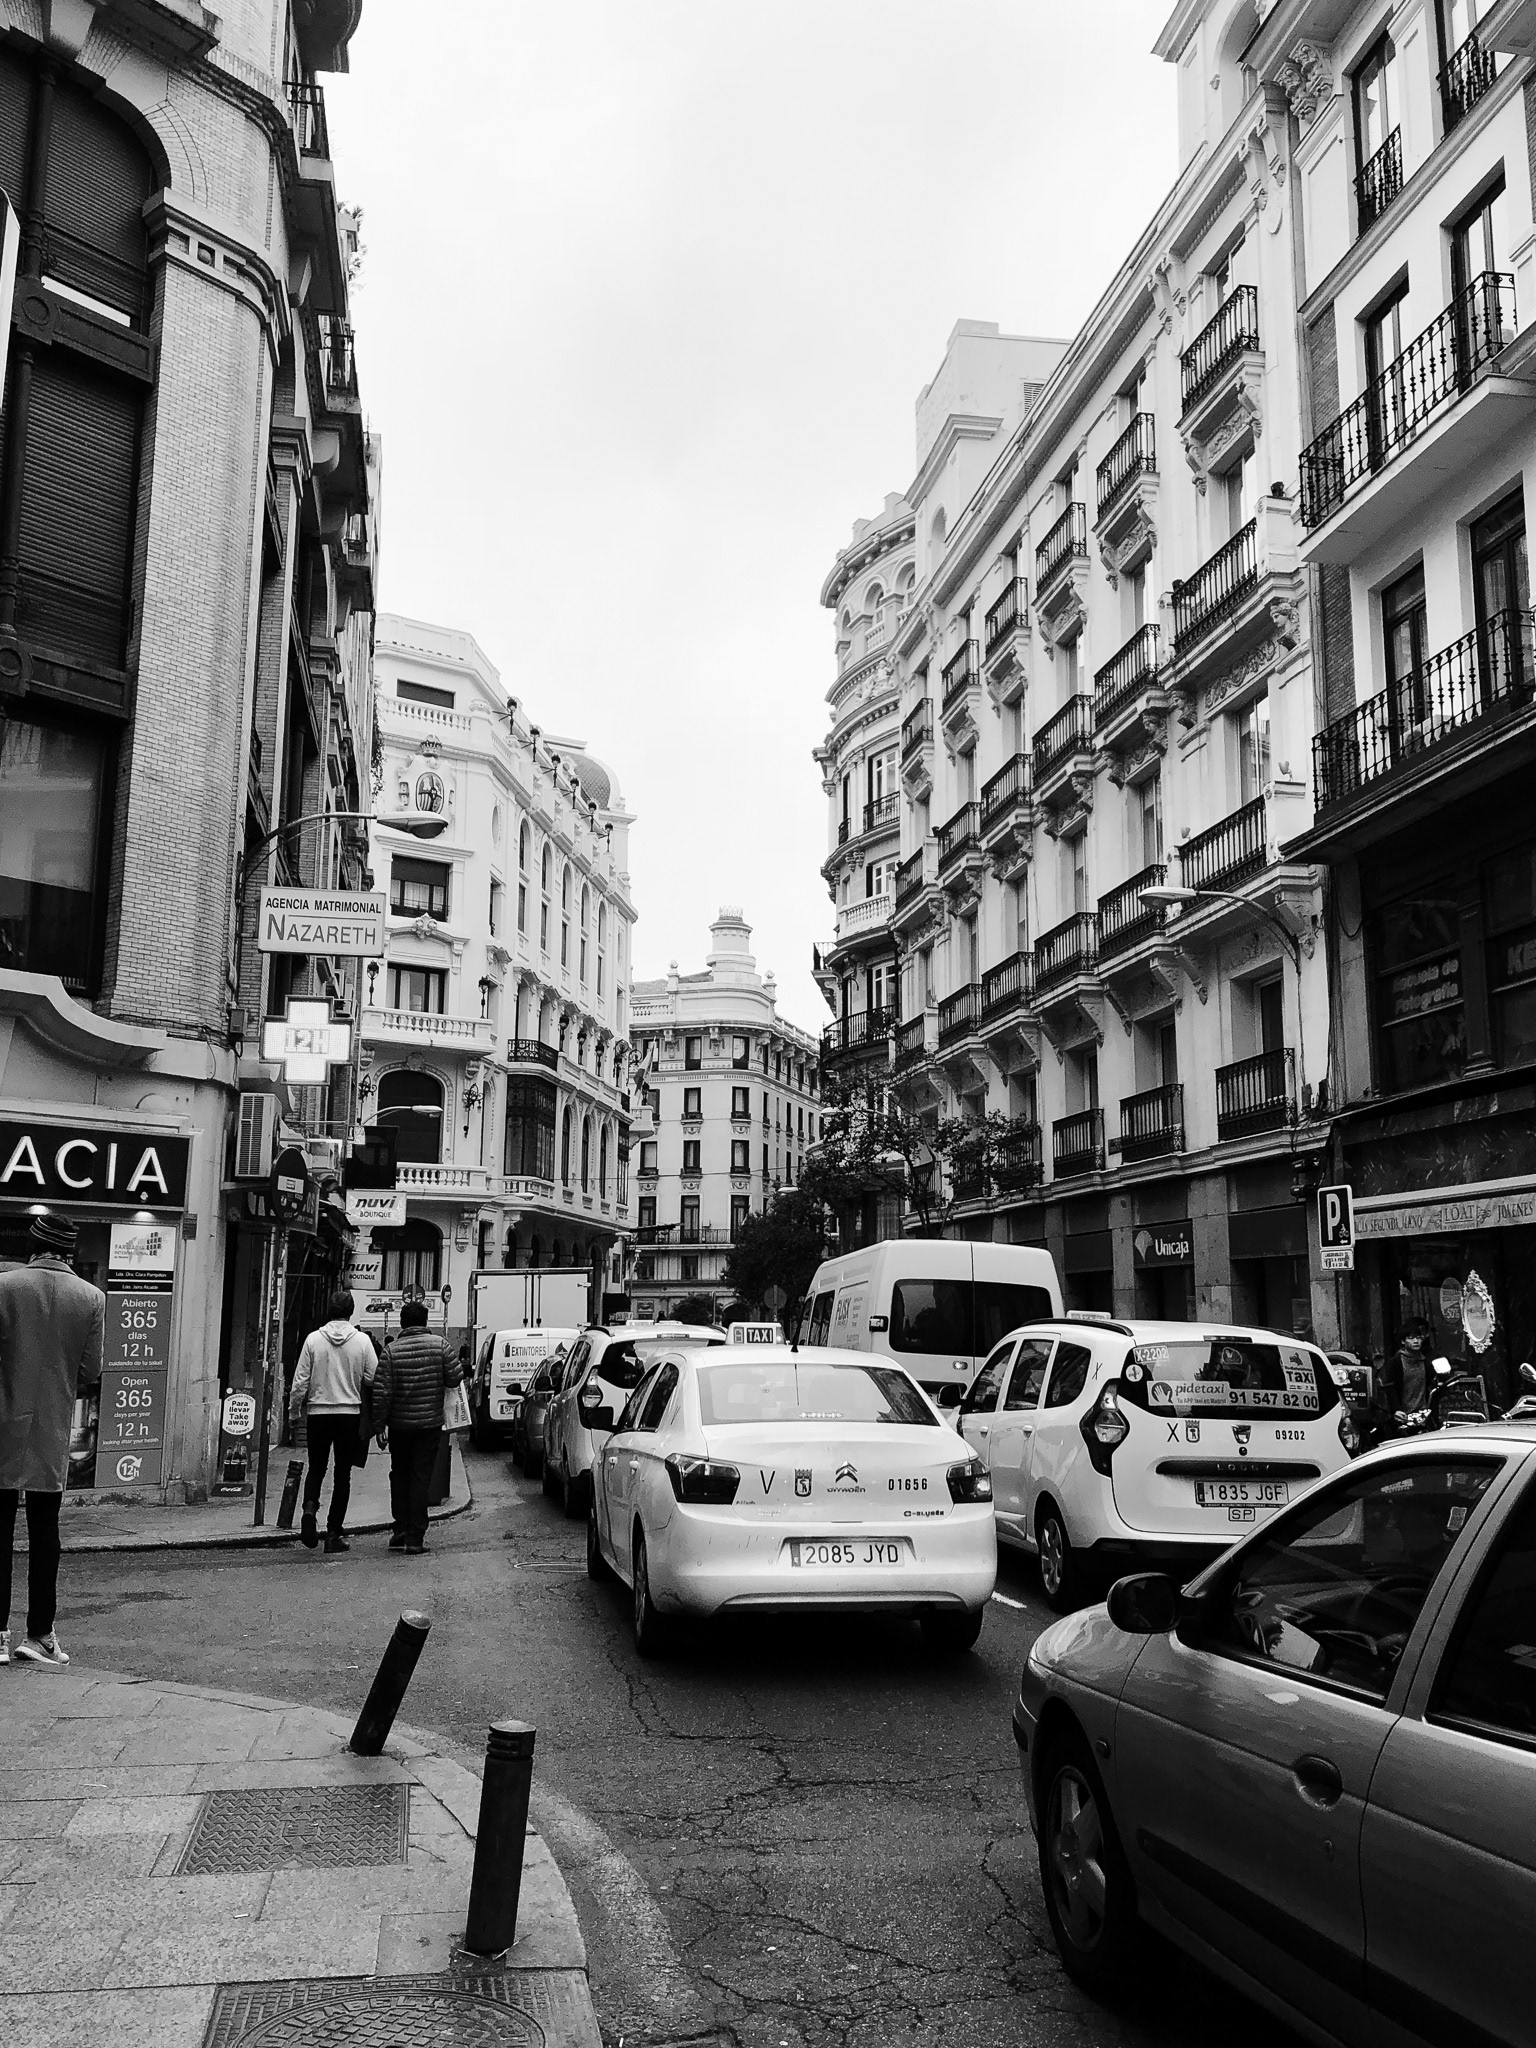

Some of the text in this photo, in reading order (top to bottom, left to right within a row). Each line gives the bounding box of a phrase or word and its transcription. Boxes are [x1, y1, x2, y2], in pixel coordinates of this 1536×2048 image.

[265, 897, 381, 914] AGENCIA MATRIMONIAL
[267, 913, 376, 945] NAZARETH
[285, 1028, 331, 1055] 12H
[0, 1135, 169, 1194] ACIA
[355, 1196, 397, 1209] nuvi
[1326, 1193, 1341, 1241] P
[1155, 1232, 1190, 1259] Unicaja
[346, 1261, 380, 1273] nuvi
[121, 1298, 158, 1308] Abierto
[120, 1310, 157, 1329] 365
[127, 1331, 148, 1340] días
[747, 1328, 773, 1343] TAXI
[121, 1343, 154, 1357] 12 h
[511, 1345, 547, 1357] EXTINTORES
[1135, 1348, 1169, 1362] X-2202
[1091, 1362, 1103, 1381] X
[1285, 1370, 1315, 1385] Taxi
[121, 1376, 149, 1388] Open
[1175, 1382, 1225, 1396] pidetaxi
[115, 1389, 152, 1408] 365
[1229, 1391, 1318, 1409] 91 547 82 00
[116, 1422, 150, 1437] 12 h
[227, 1419, 250, 1427] away
[1166, 1422, 1180, 1443] X
[1275, 1429, 1306, 1441] 09202
[121, 1462, 140, 1478] 12h
[760, 1470, 776, 1495] V
[888, 1478, 929, 1491] 01656
[1209, 1484, 1283, 1501] 1835 JGF
[1231, 1509, 1253, 1520] SP
[805, 1544, 899, 1564] 2085 JYD
